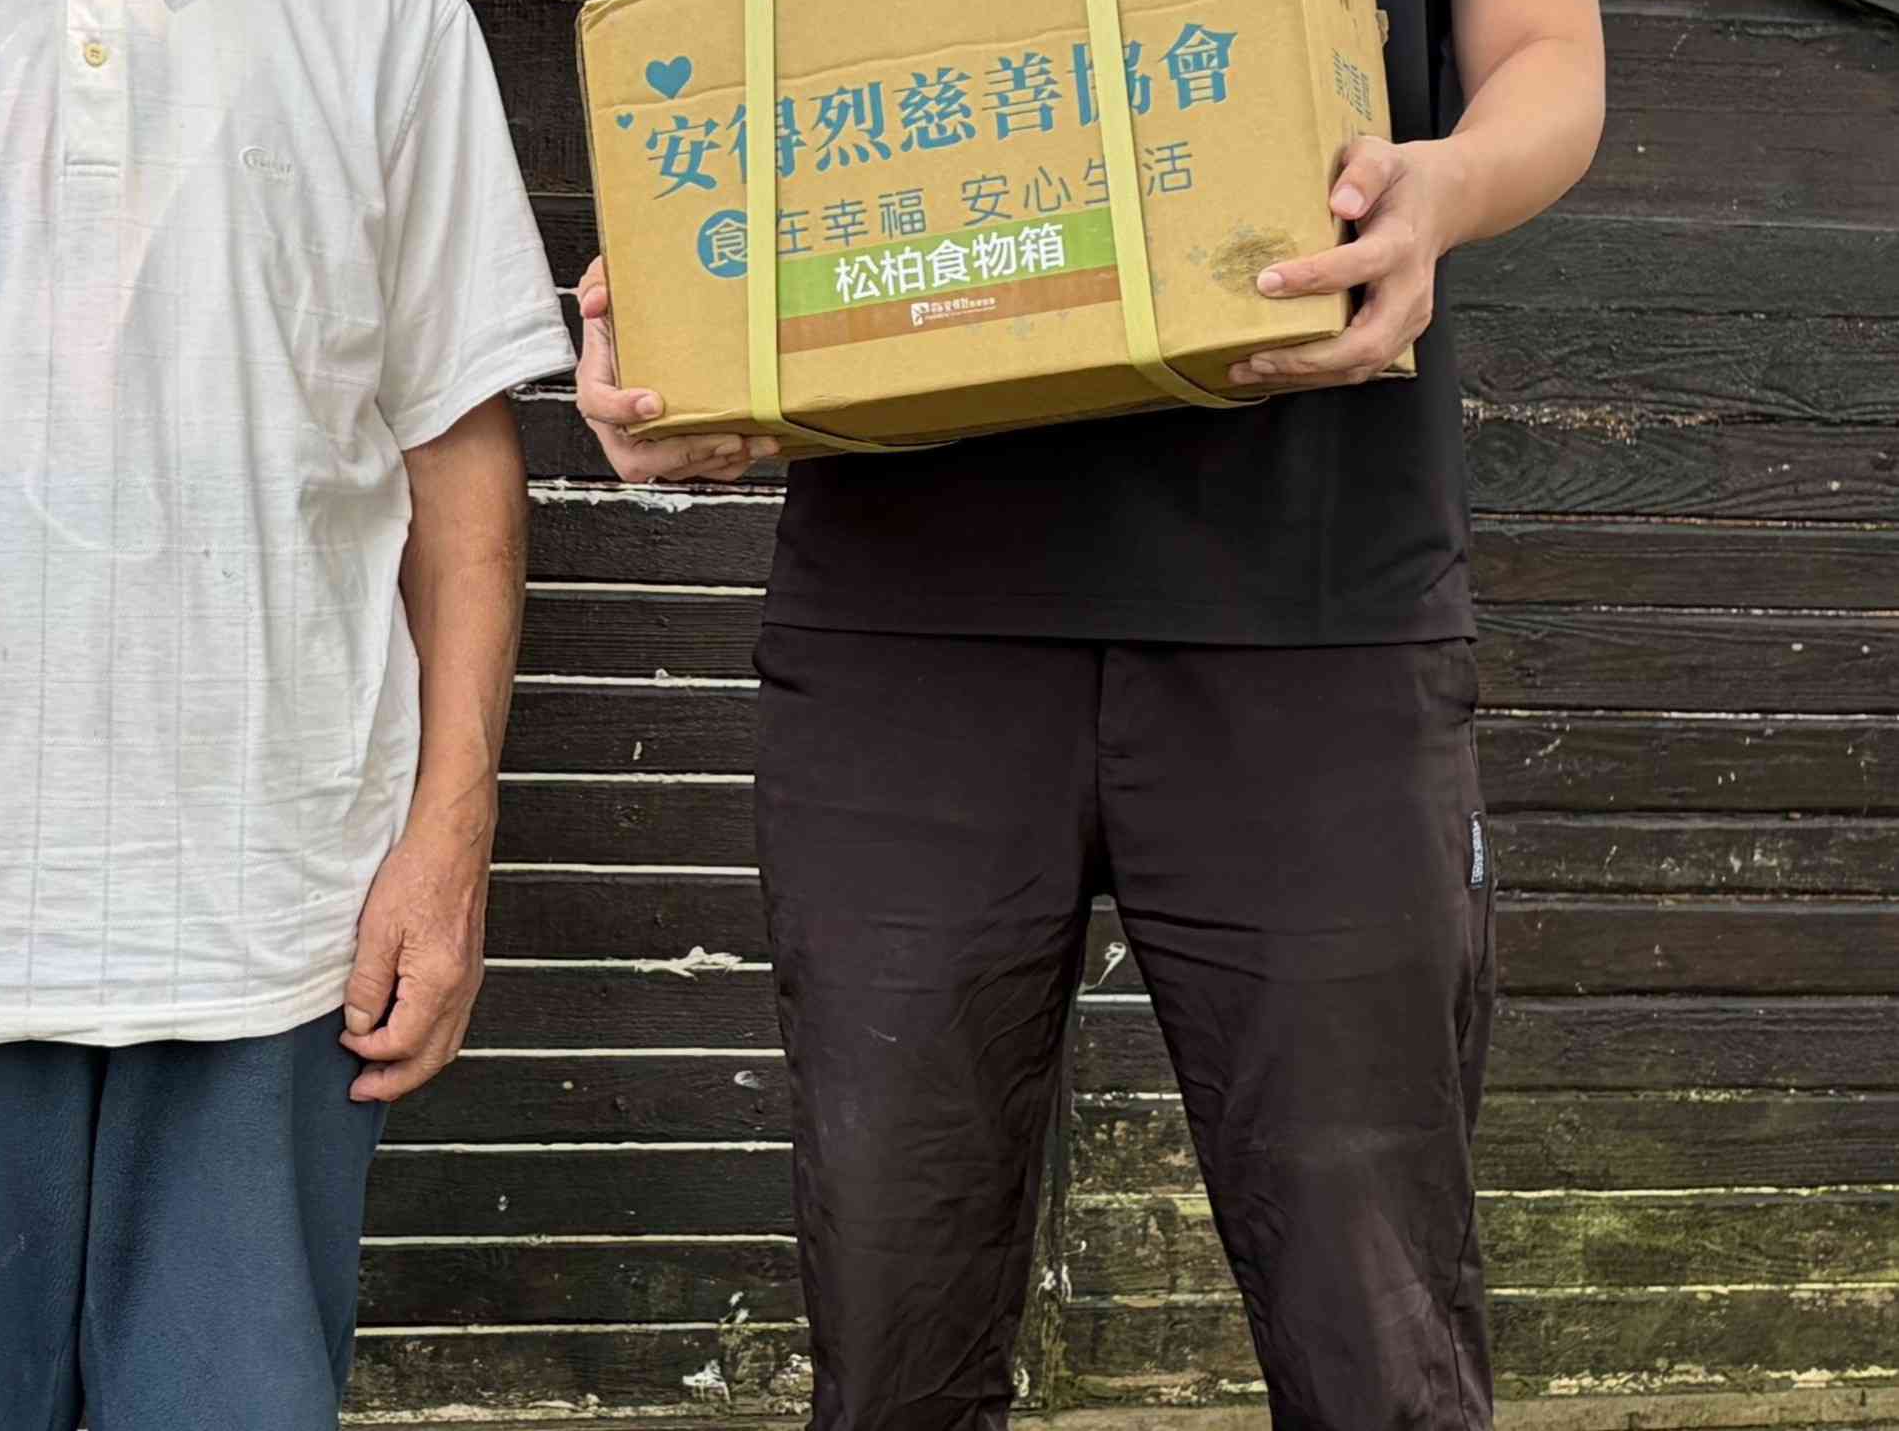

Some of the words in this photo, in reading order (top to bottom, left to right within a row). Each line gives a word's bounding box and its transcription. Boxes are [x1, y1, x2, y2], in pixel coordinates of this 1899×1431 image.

[645, 22, 1238, 201] 安得烈慈善協會
[834, 222, 1065, 305] 松柏食物箱
